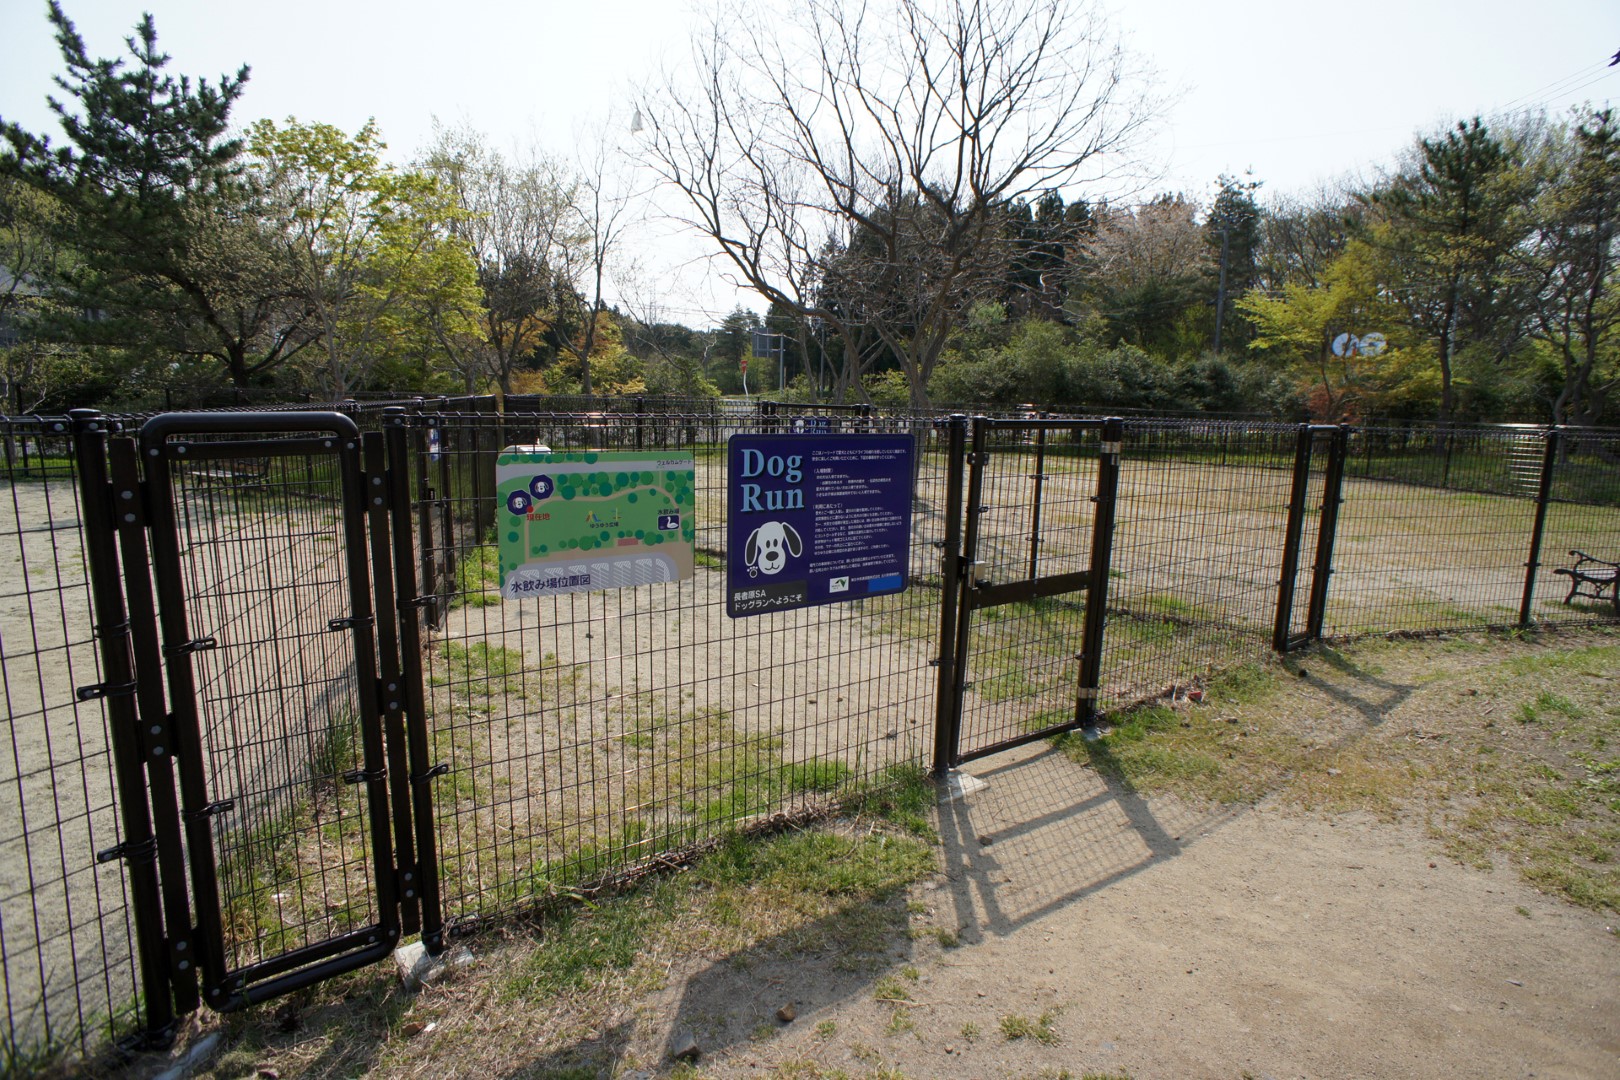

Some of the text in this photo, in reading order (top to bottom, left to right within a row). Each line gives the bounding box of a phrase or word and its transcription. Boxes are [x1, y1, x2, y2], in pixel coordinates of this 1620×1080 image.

[741, 449, 803, 483] Dog
[741, 484, 805, 512] Run
[527, 513, 551, 521] 現在地
[511, 574, 591, 593] 水飲み場位置図
[734, 589, 767, 602] 長者原SA
[734, 593, 802, 611] ドッグランへようこそ
